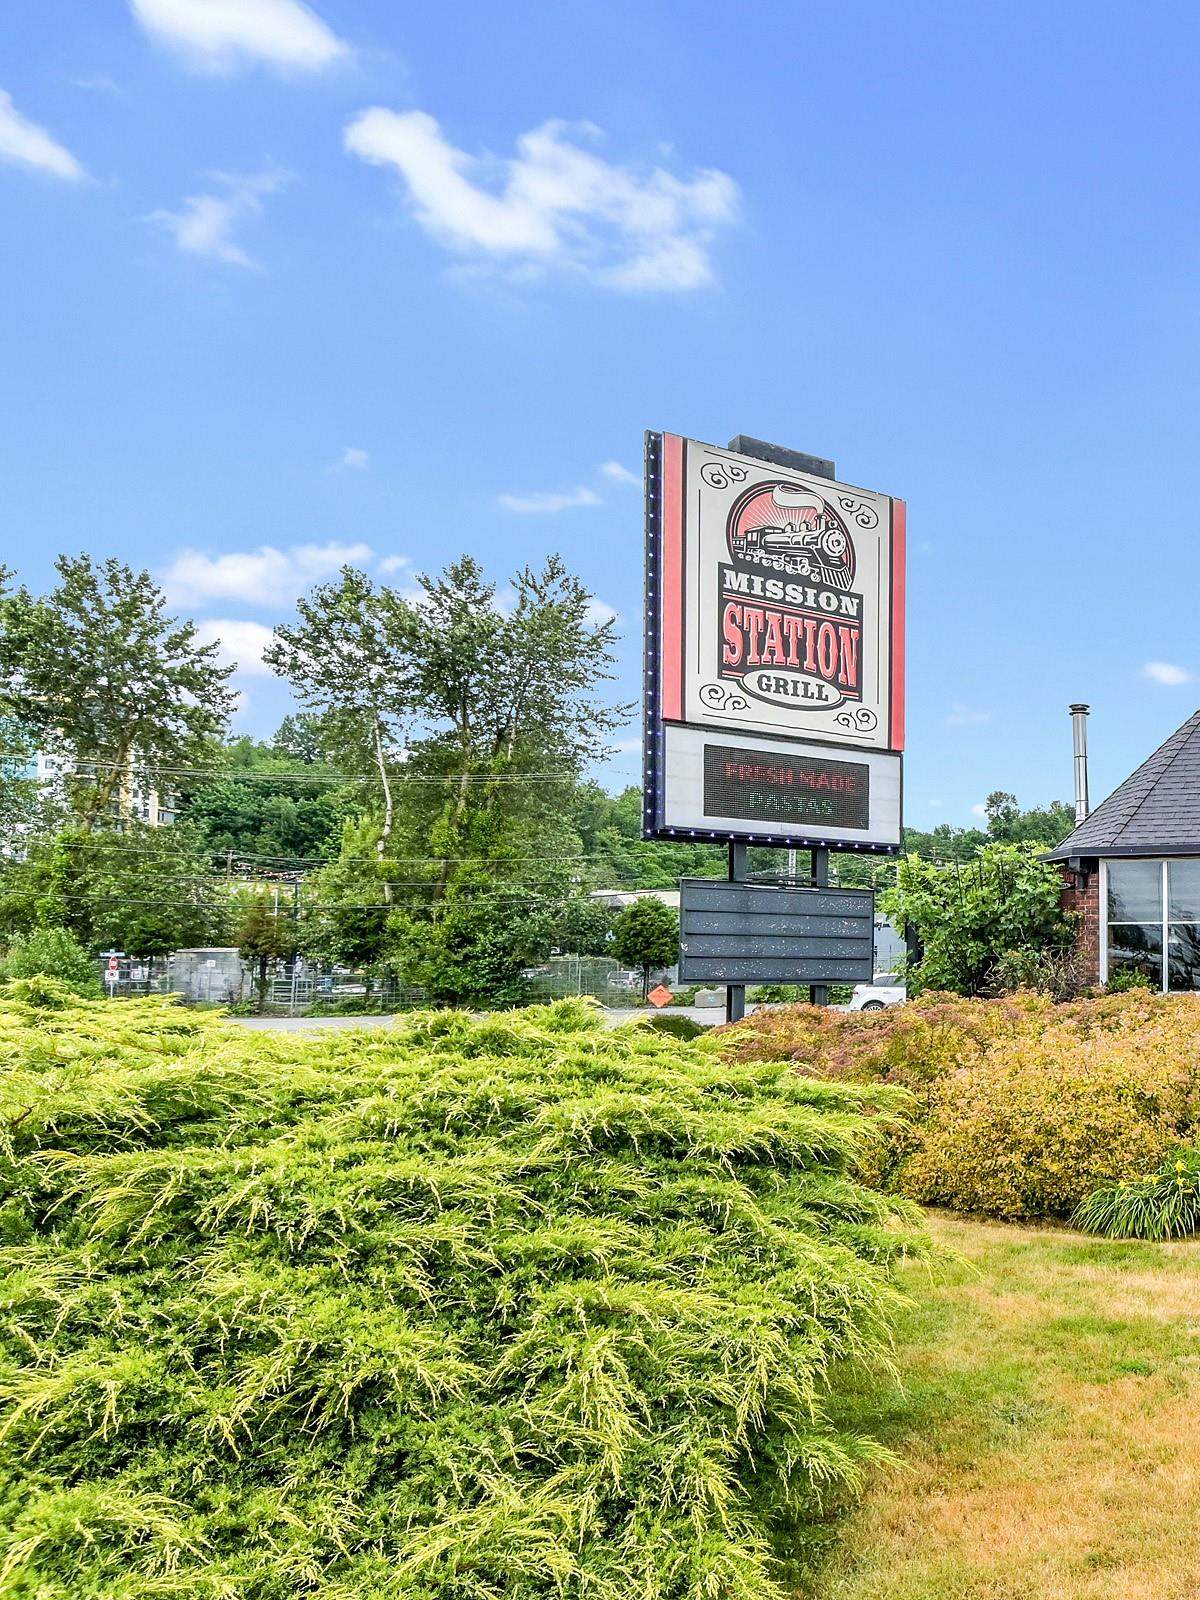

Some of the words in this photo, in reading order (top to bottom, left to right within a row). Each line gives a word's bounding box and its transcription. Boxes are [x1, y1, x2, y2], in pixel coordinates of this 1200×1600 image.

[723, 569, 859, 616] MISSION
[722, 602, 859, 688] STATION
[757, 674, 829, 702] GRILL
[724, 762, 793, 785] FRESH
[799, 770, 856, 792] MADE
[749, 792, 833, 815] PASTAS
